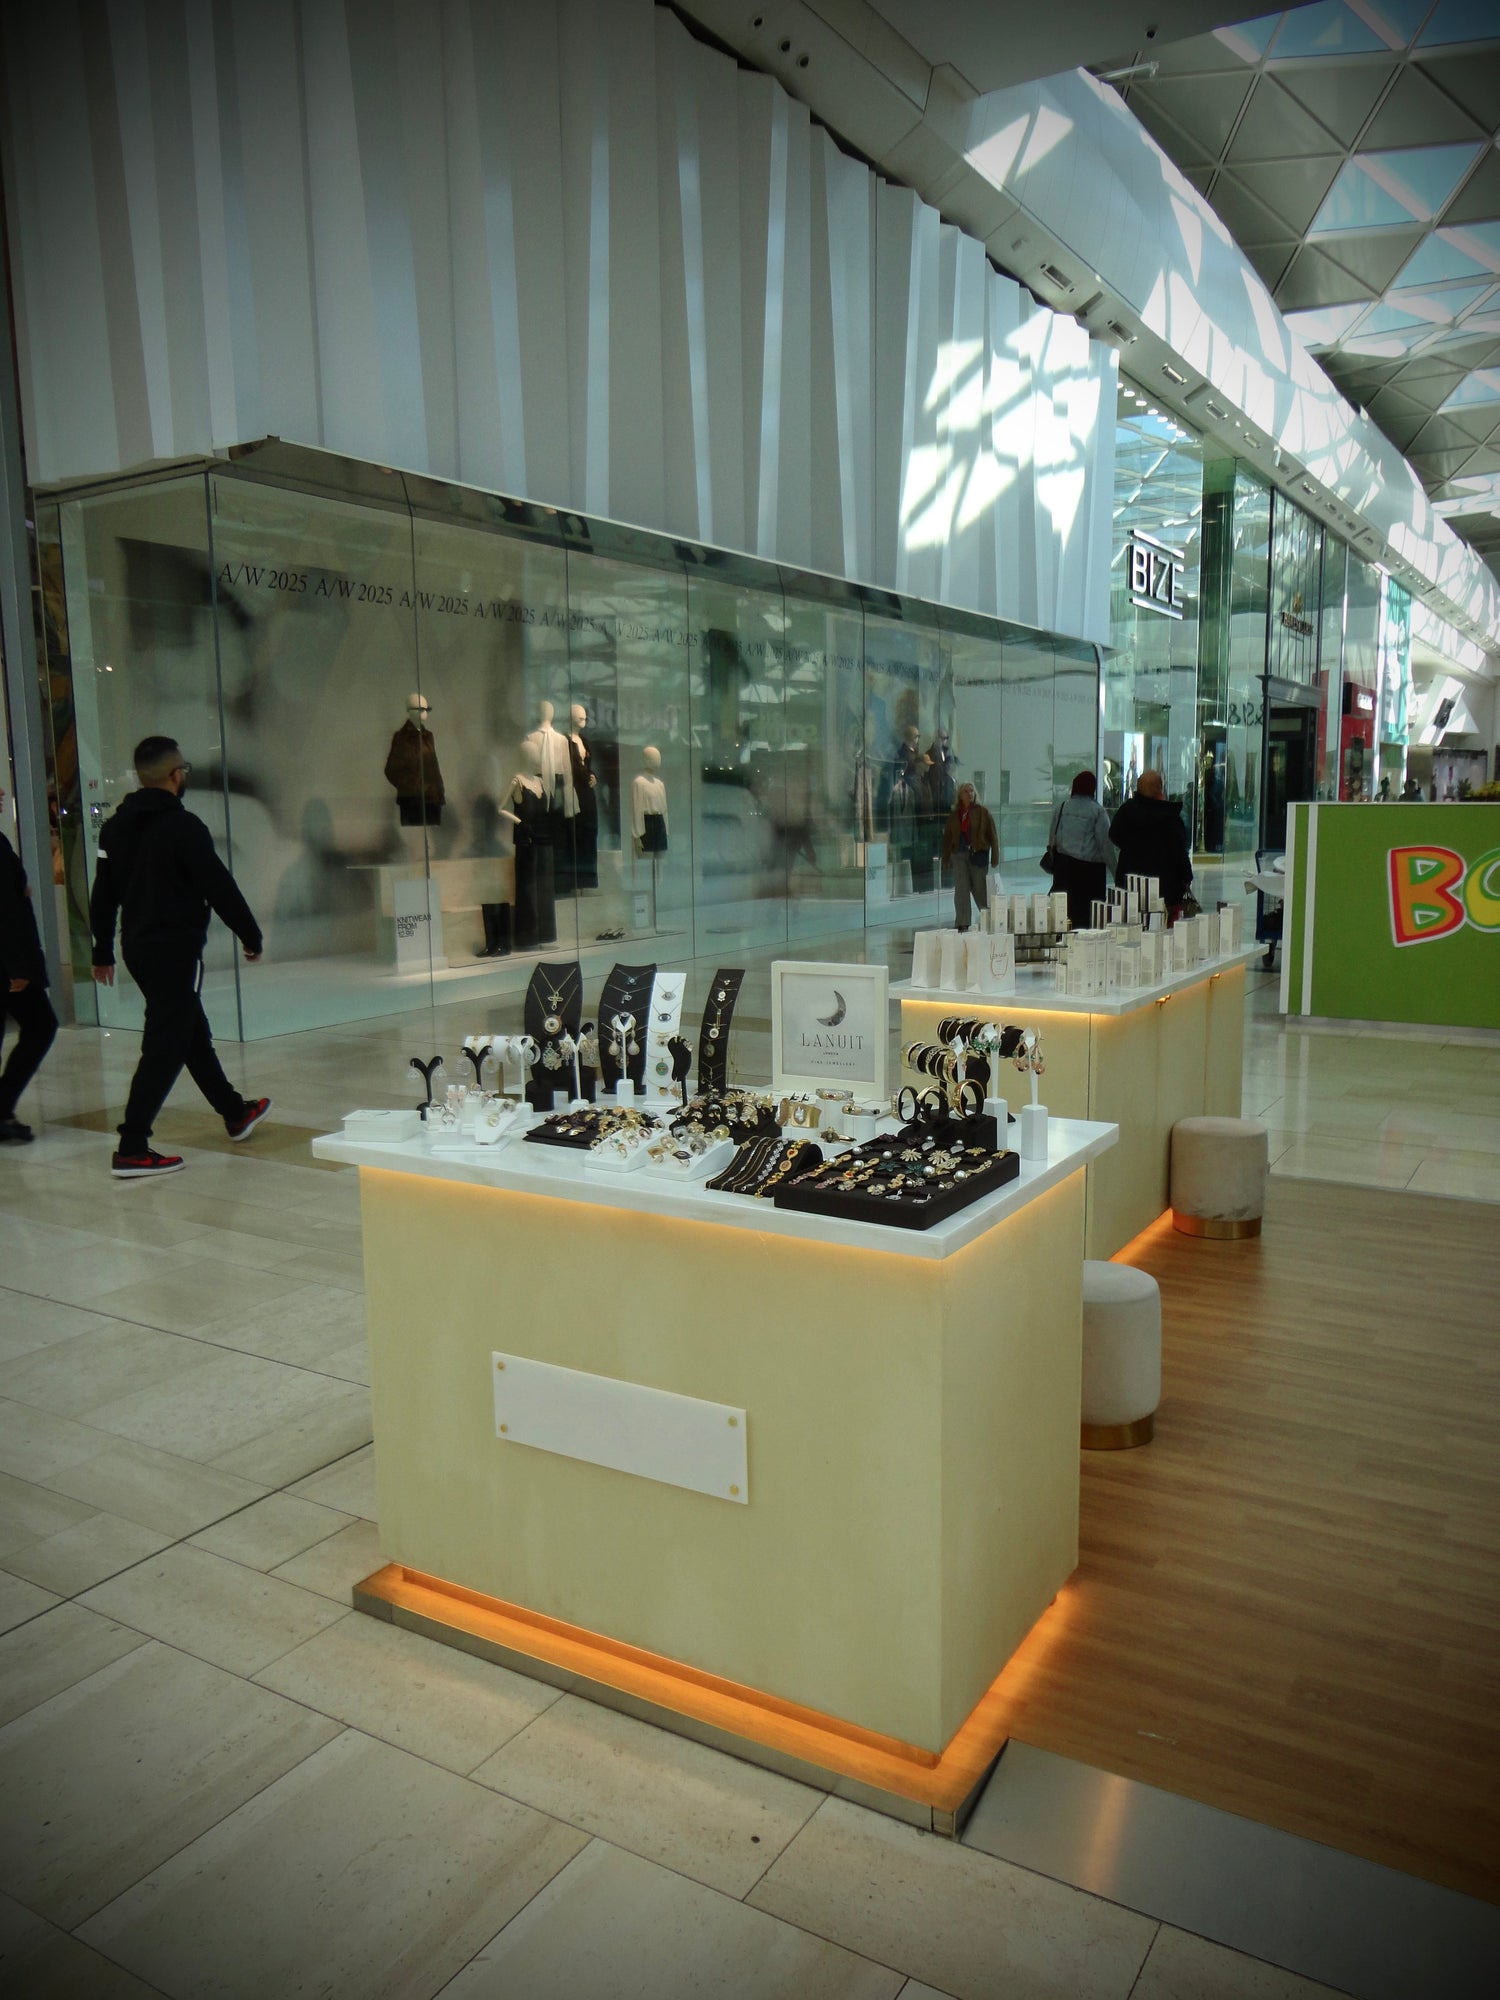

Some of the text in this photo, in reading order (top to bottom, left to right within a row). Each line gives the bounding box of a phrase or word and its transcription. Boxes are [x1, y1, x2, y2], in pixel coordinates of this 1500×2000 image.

[217, 563, 265, 586] A/W
[268, 570, 308, 592] 2025
[315, 577, 356, 598] A/W
[358, 583, 393, 605] 2025
[399, 591, 436, 611] A/W
[437, 595, 469, 615] 2025
[474, 599, 507, 619] A/W
[507, 606, 536, 624] 2025
[1130, 543, 1184, 608] BIZE
[802, 1033, 863, 1049] LANUIT
